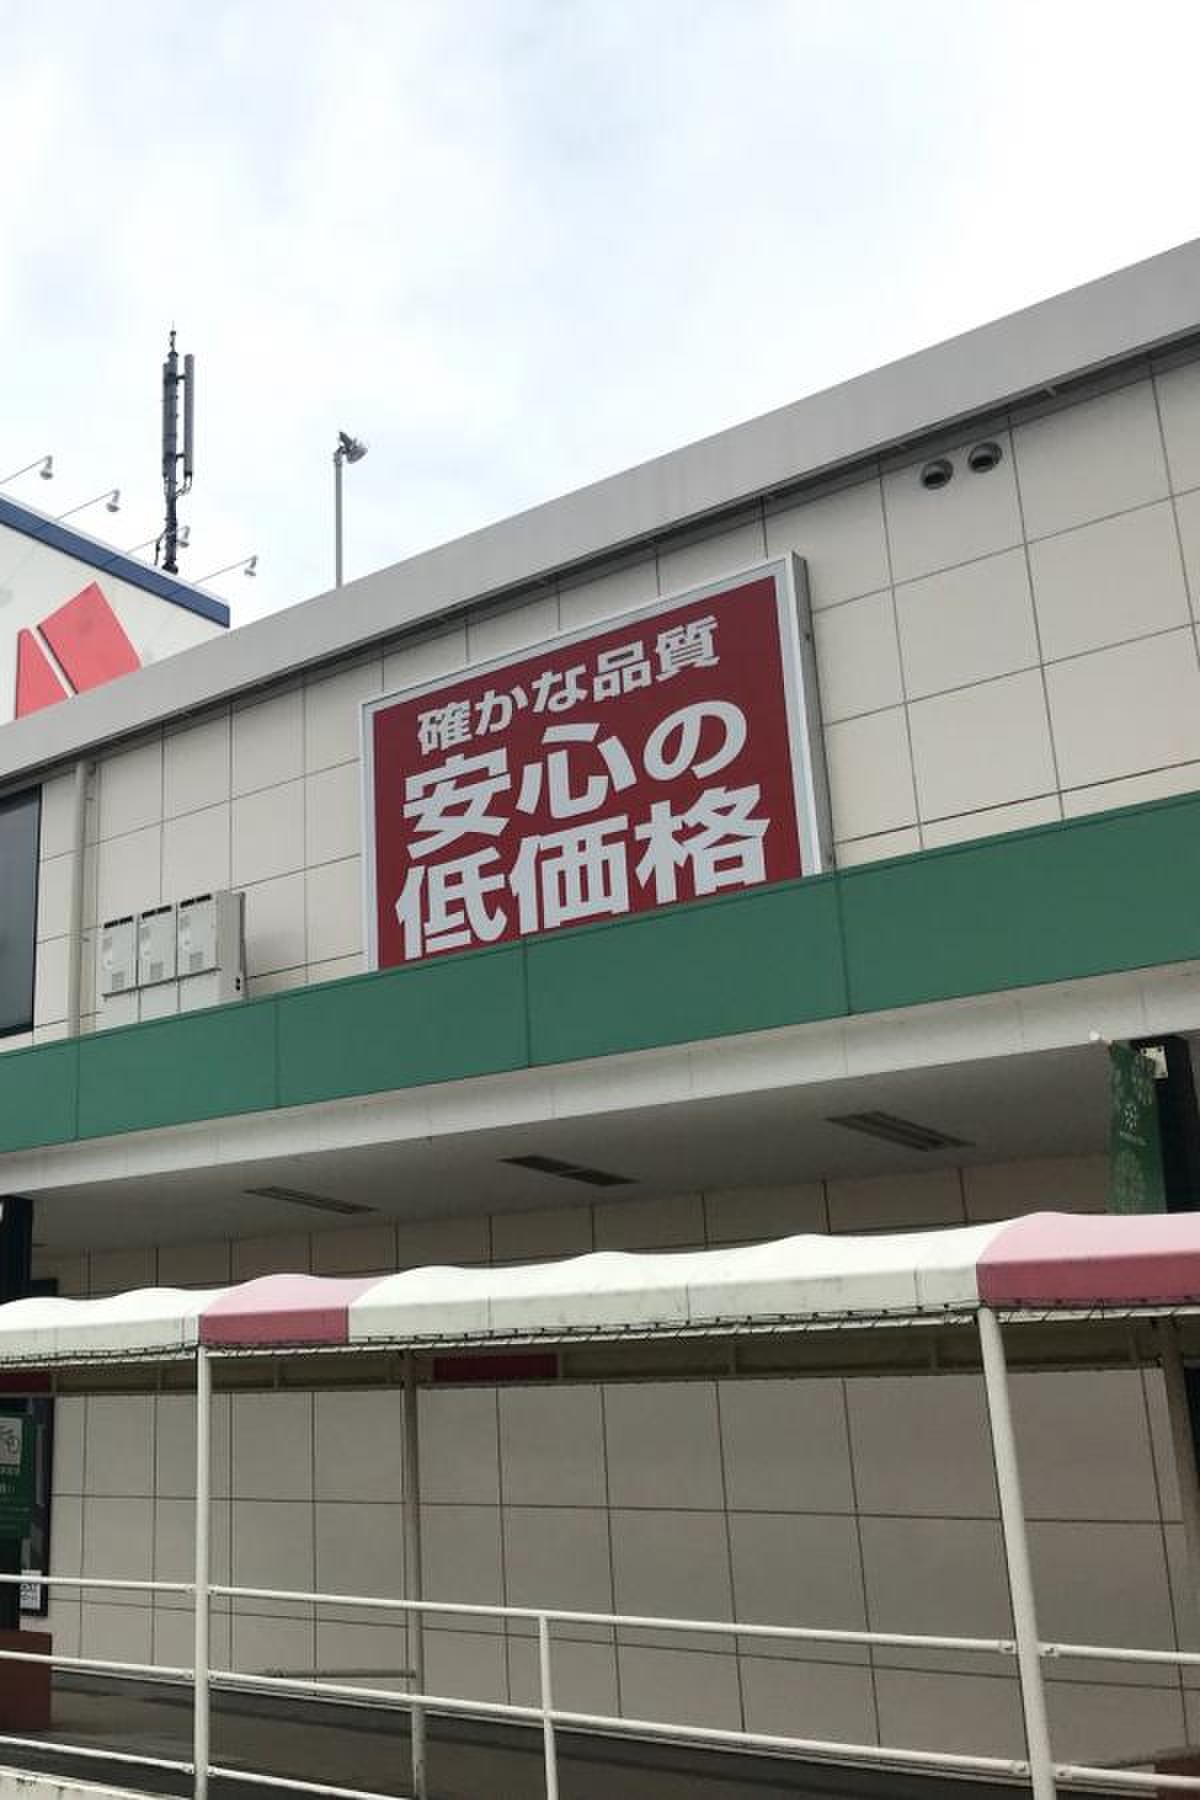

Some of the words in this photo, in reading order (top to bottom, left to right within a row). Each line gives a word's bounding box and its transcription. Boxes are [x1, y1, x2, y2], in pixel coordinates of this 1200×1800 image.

[417, 615, 720, 755] 確かな品質
[403, 699, 747, 860] 安心の
[396, 784, 770, 961] 低価格
